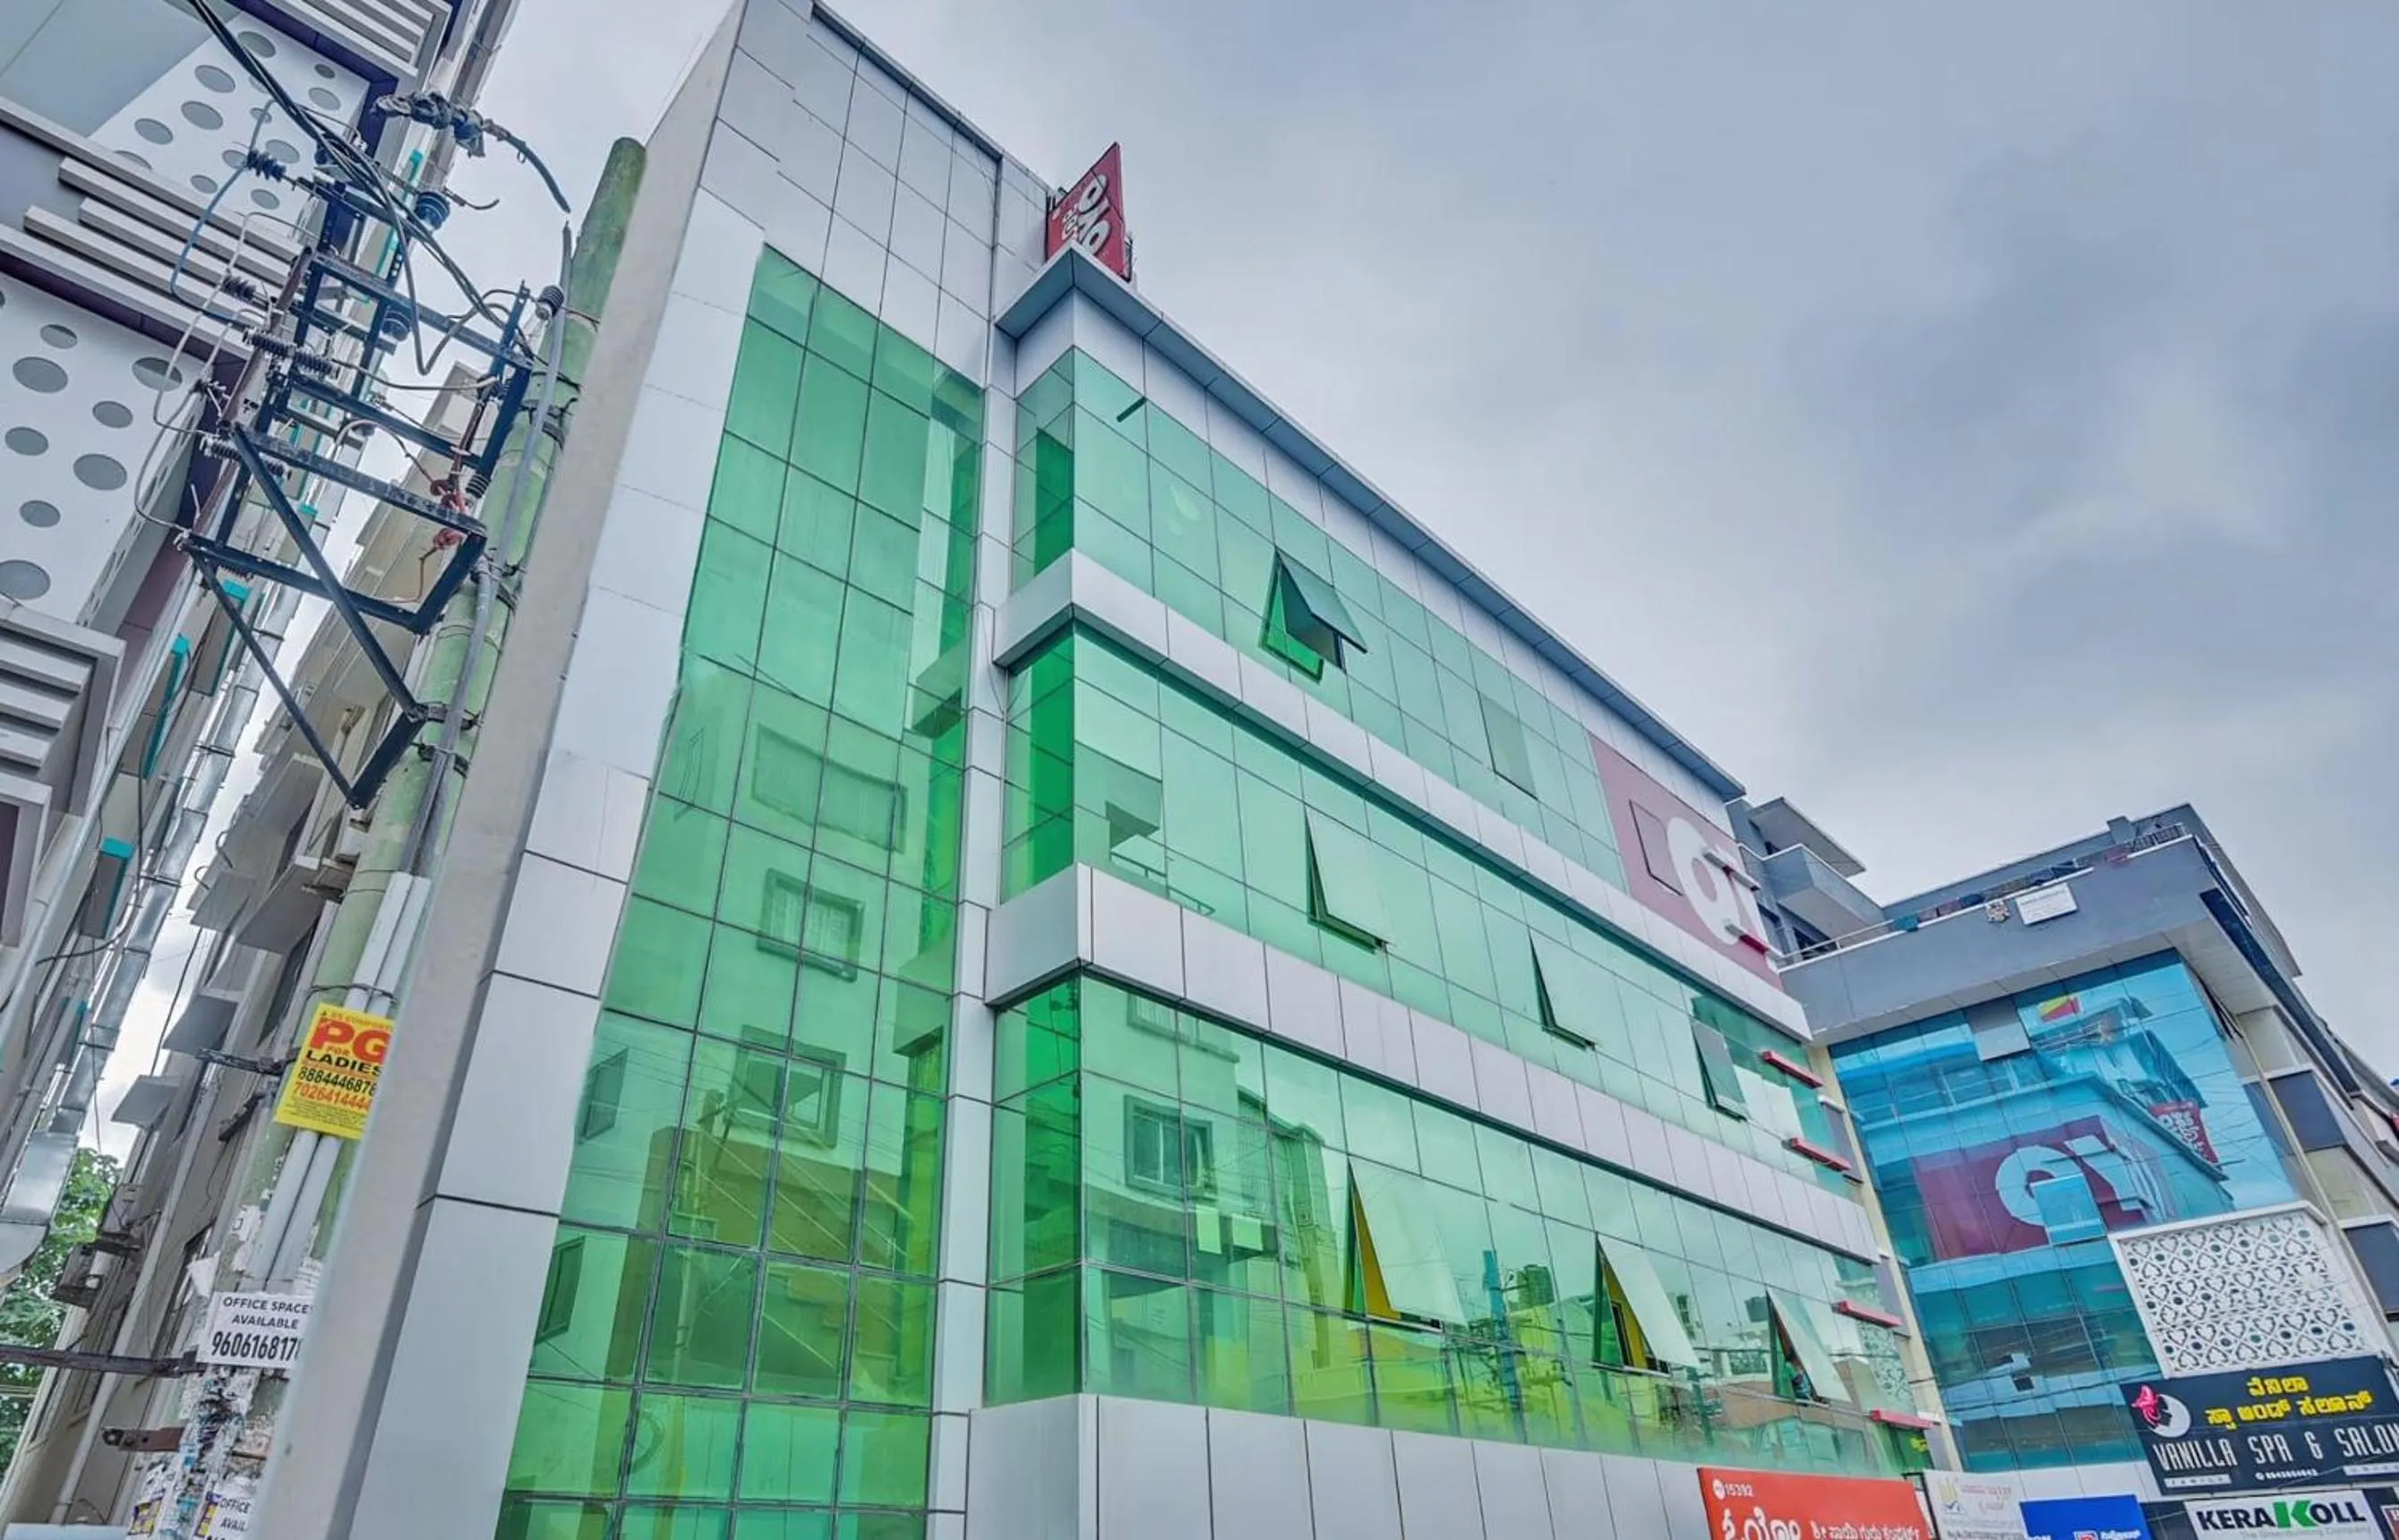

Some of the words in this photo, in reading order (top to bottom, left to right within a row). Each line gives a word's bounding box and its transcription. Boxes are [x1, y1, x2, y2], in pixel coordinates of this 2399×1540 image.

[309, 1019, 391, 1065] PG
[306, 1050, 381, 1077] LADIES
[223, 1296, 269, 1310] OFFICE
[271, 1301, 313, 1313] SPACE
[232, 1313, 299, 1329] AVAILABLE
[211, 1330, 302, 1361] 960616817
[2153, 1438, 2238, 1471] VANILLA
[2248, 1433, 2294, 1465] SPA
[2305, 1431, 2324, 1459] &
[220, 1498, 252, 1514] OFFICE
[2197, 1500, 2367, 1530] KERAKOLL
